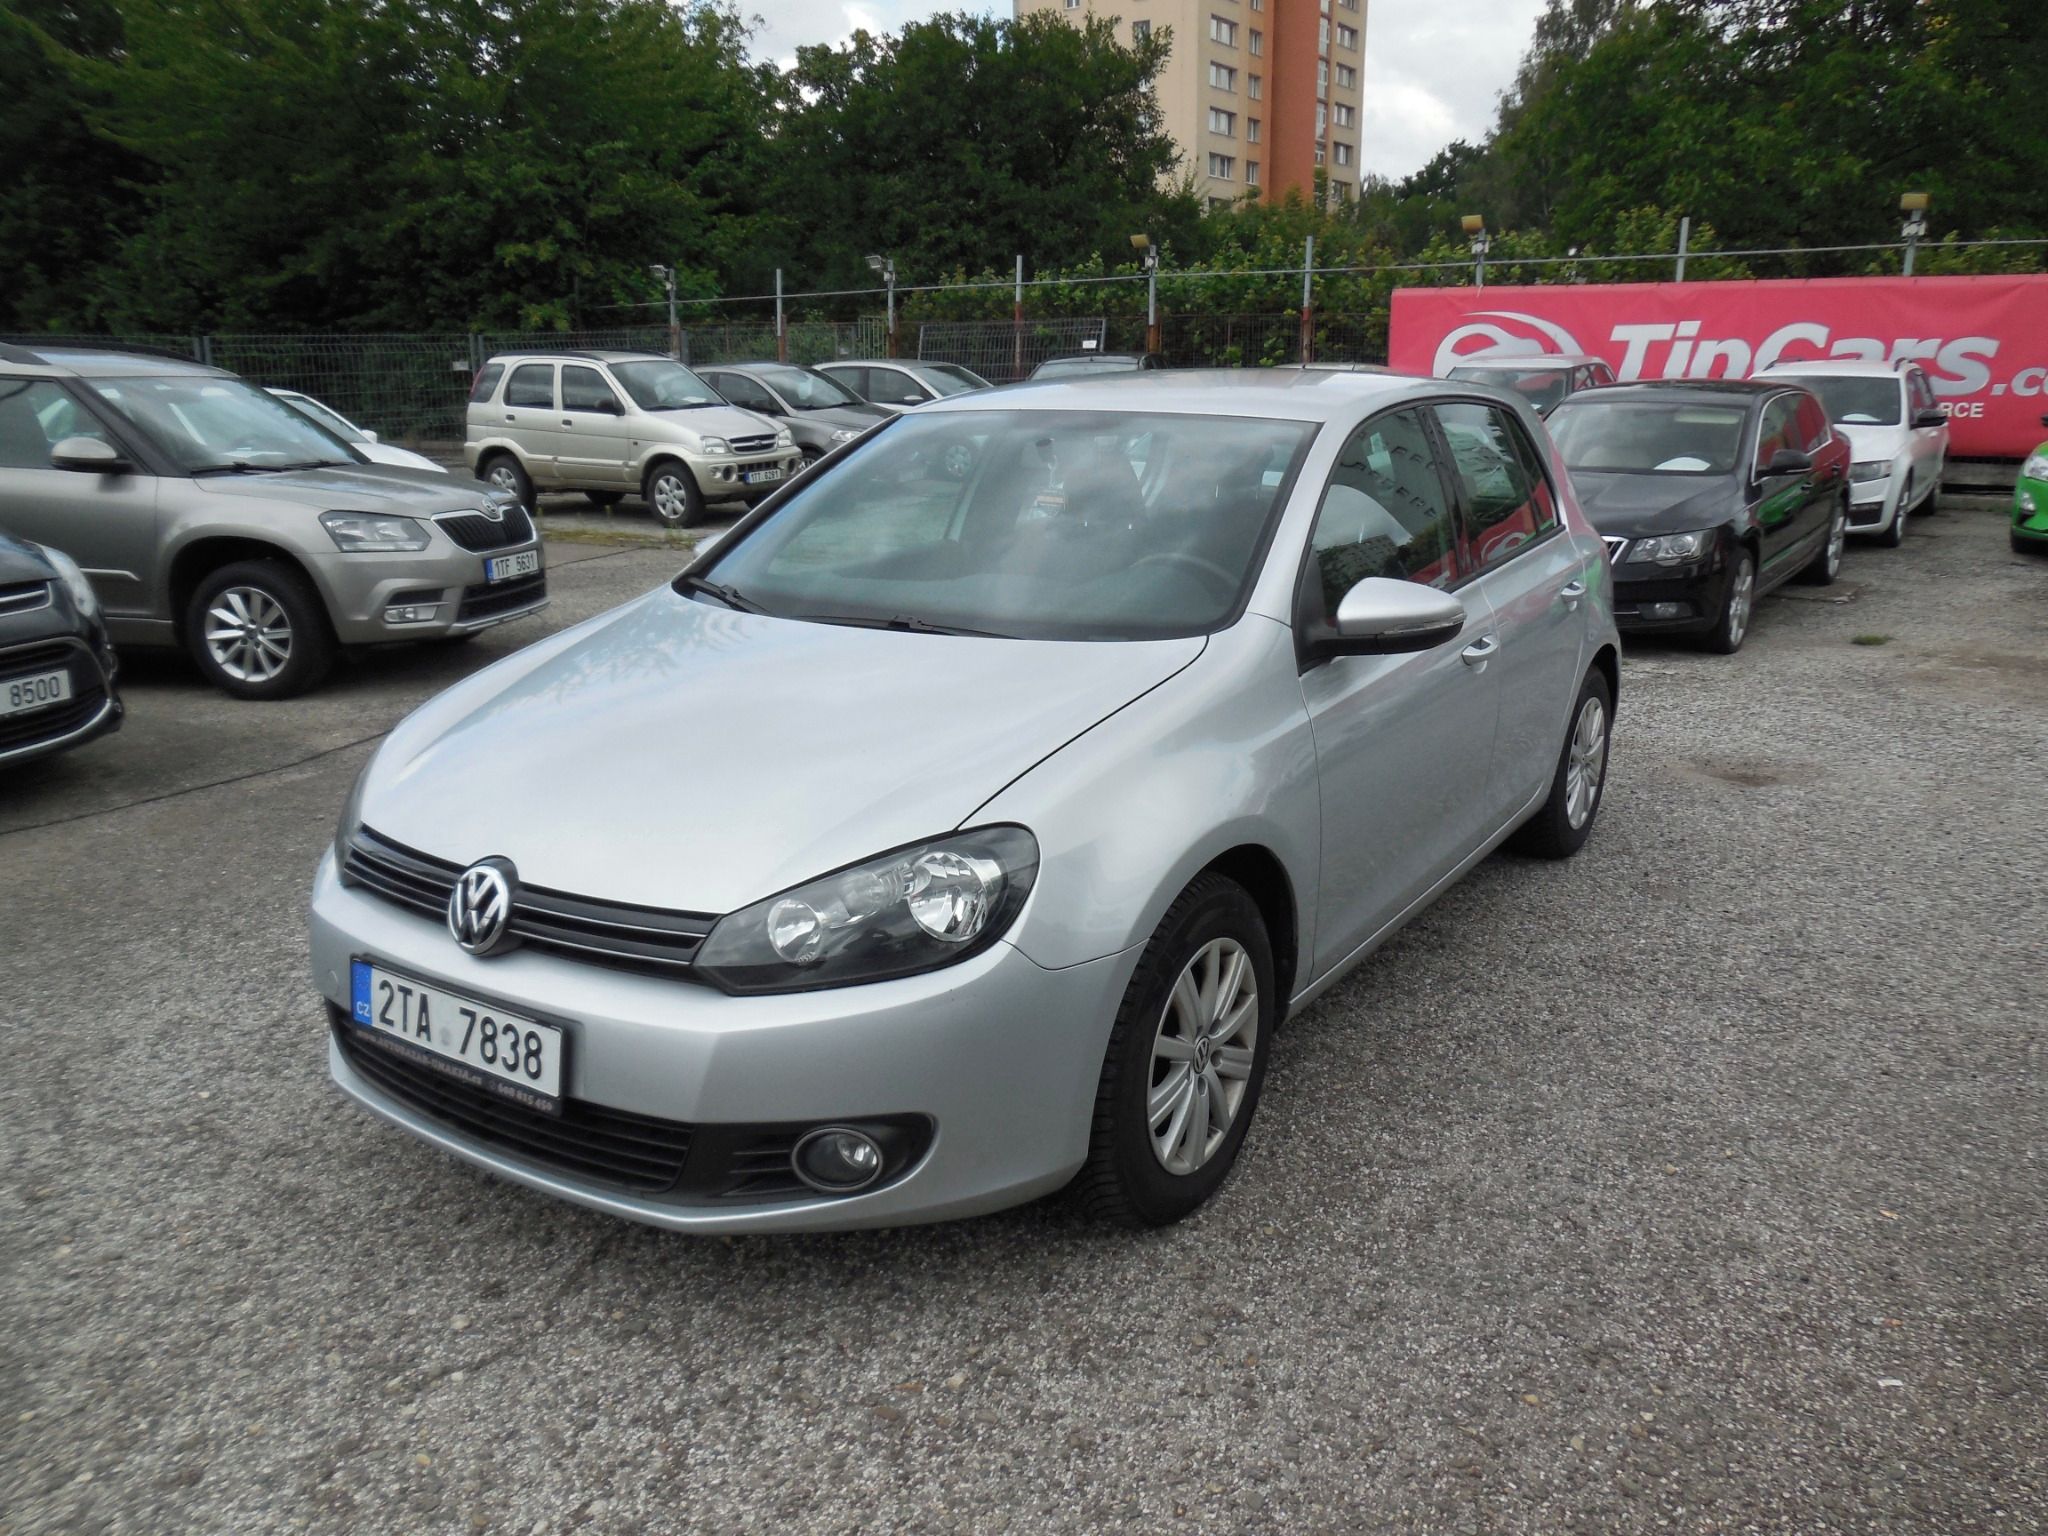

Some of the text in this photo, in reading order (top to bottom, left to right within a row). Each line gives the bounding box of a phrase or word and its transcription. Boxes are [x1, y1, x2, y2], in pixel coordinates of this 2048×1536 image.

[495, 558, 510, 577] 1TF
[10, 676, 60, 707] 8500
[356, 1001, 370, 1017] CZ
[379, 980, 431, 1042] 2TA
[459, 1007, 542, 1080] 7838
